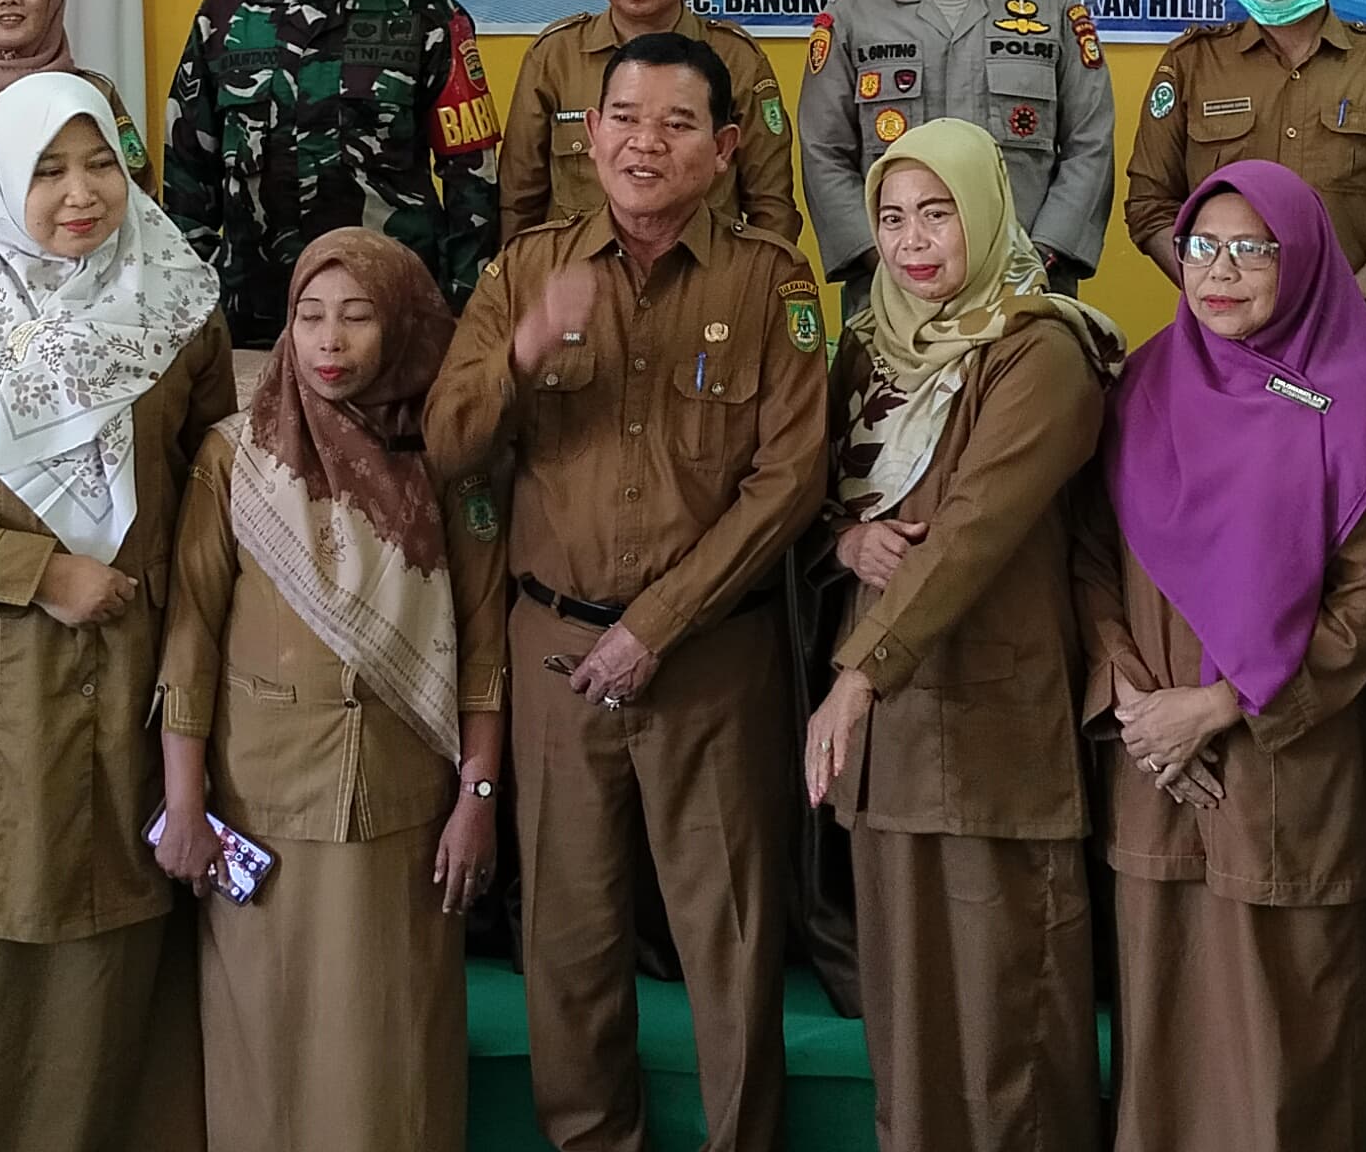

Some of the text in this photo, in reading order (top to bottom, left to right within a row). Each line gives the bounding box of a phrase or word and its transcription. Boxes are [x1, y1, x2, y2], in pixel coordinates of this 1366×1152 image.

[348, 48, 416, 62] TNI-AD
[869, 44, 917, 60] GINTING
[990, 40, 1054, 59] POLRI
